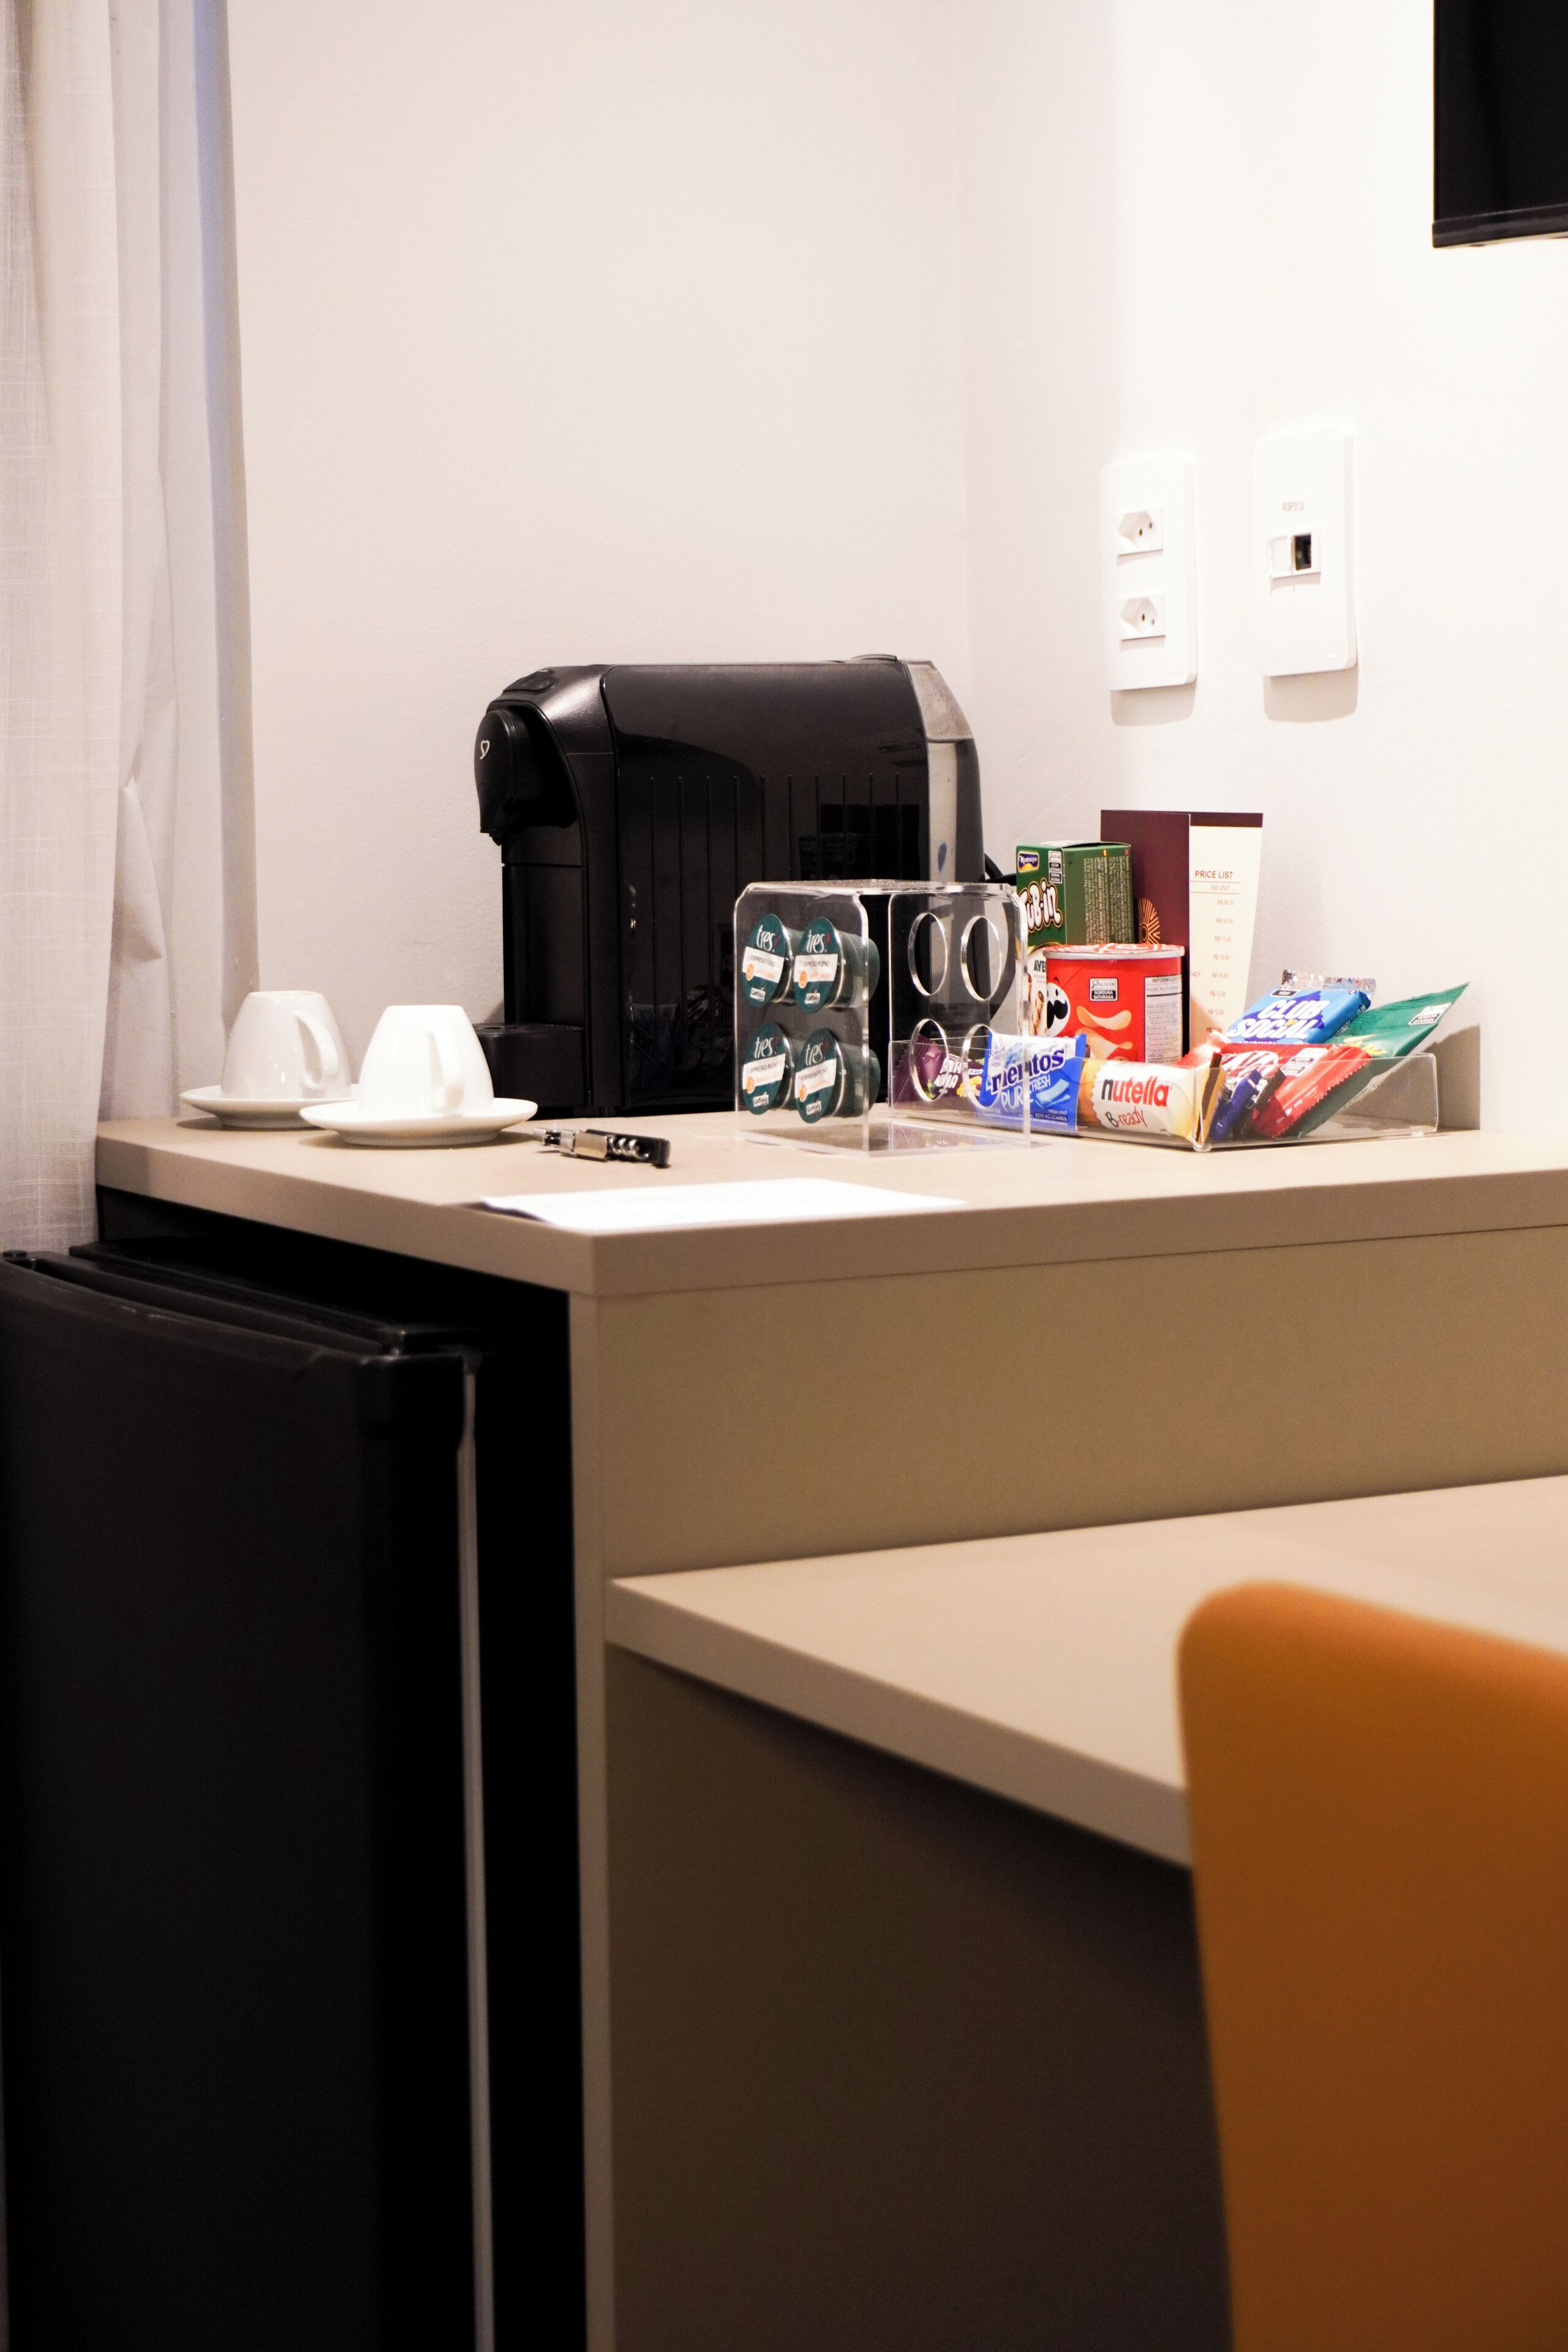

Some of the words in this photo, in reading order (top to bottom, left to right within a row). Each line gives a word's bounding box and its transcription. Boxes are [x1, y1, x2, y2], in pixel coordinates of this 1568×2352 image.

[1034, 959, 1047, 973] AVE
[1257, 1000, 1330, 1019] CLUB
[992, 1049, 1065, 1092] mentos
[1001, 1082, 1033, 1112] PUR
[1031, 1075, 1050, 1092] FRESH
[1101, 1076, 1169, 1107] nutella
